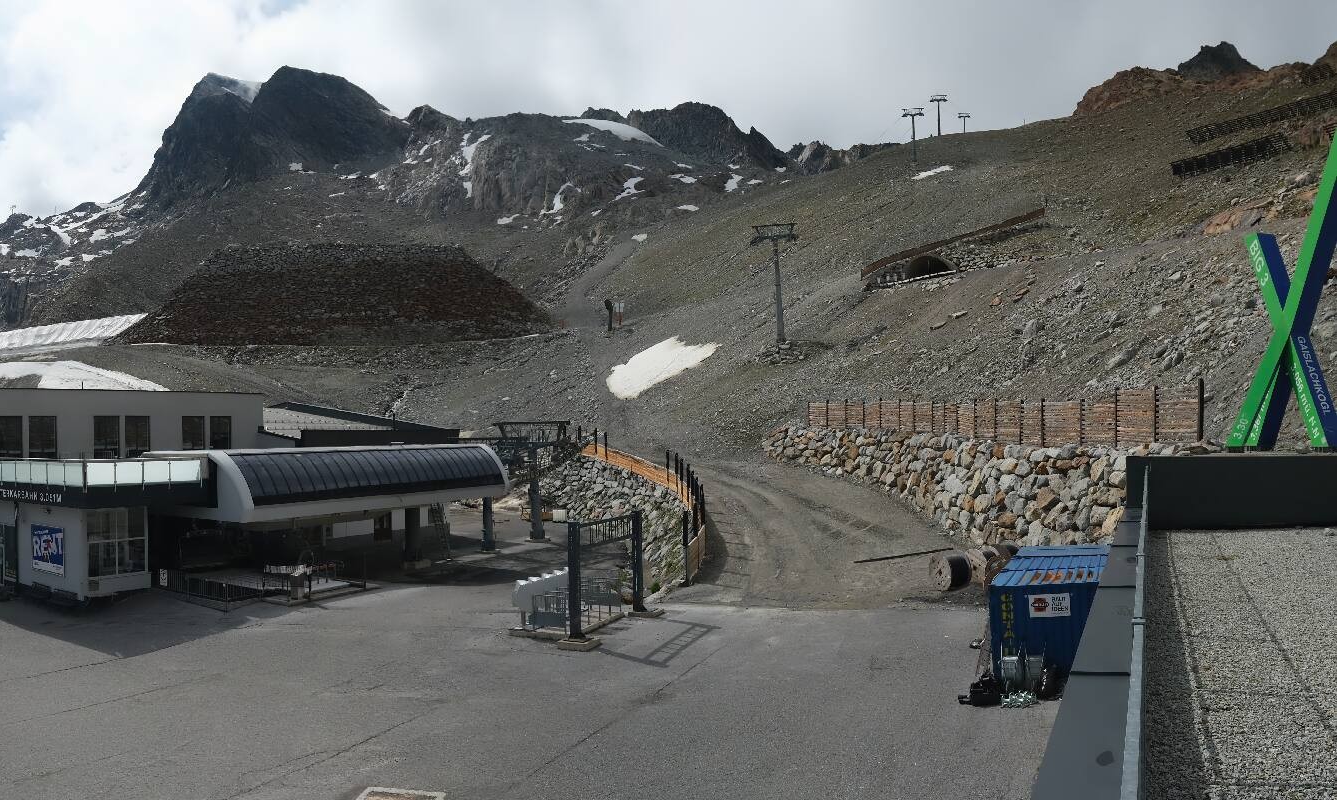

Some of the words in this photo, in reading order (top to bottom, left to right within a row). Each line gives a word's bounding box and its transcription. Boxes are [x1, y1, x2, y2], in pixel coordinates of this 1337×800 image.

[1249, 239, 1265, 273] BIG
[1260, 272, 1269, 287] 3
[1297, 335, 1331, 416] GAISLACHKOGL
